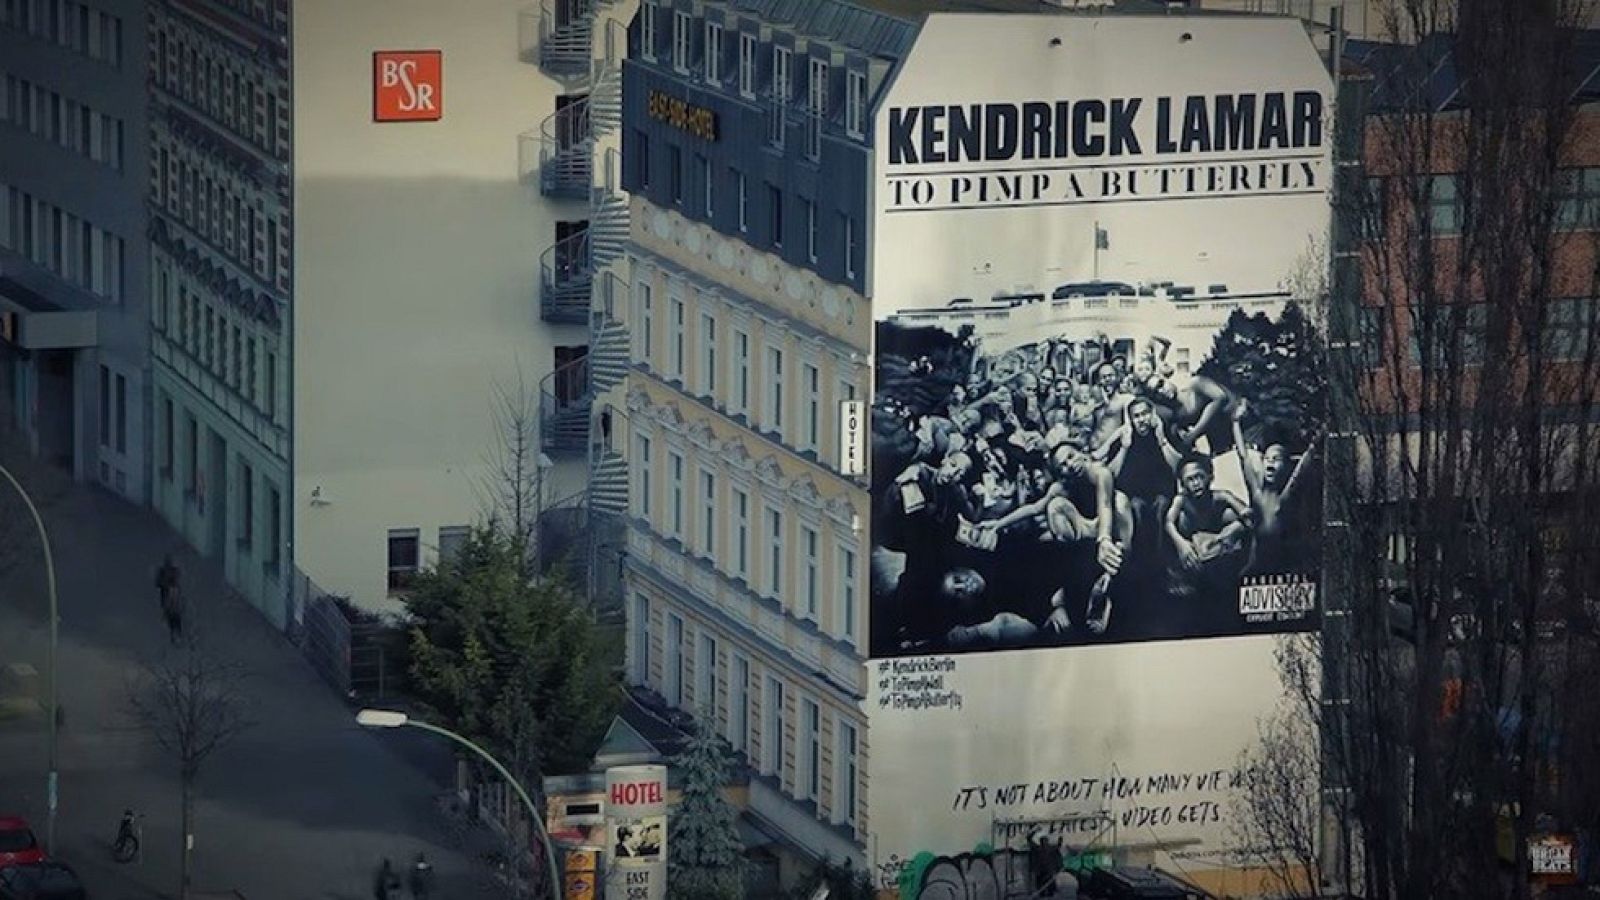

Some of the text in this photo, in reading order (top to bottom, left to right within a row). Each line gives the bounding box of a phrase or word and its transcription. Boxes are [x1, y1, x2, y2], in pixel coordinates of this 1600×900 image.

[382, 60, 436, 112] BSR
[888, 90, 1323, 165] KENDRICK LAMAR
[888, 160, 1322, 206] TO PIMP A BUTTERFLY
[848, 402, 858, 474] HOTEL
[611, 782, 663, 806] HOTEL
[952, 785, 988, 811] IT'S
[995, 783, 1029, 806] NOT
[1032, 778, 1099, 804] ABOUT
[1101, 776, 1143, 802] HOW
[1146, 773, 1192, 795] MANY
[1121, 805, 1171, 828] VIDEO
[626, 872, 649, 886] EAST
